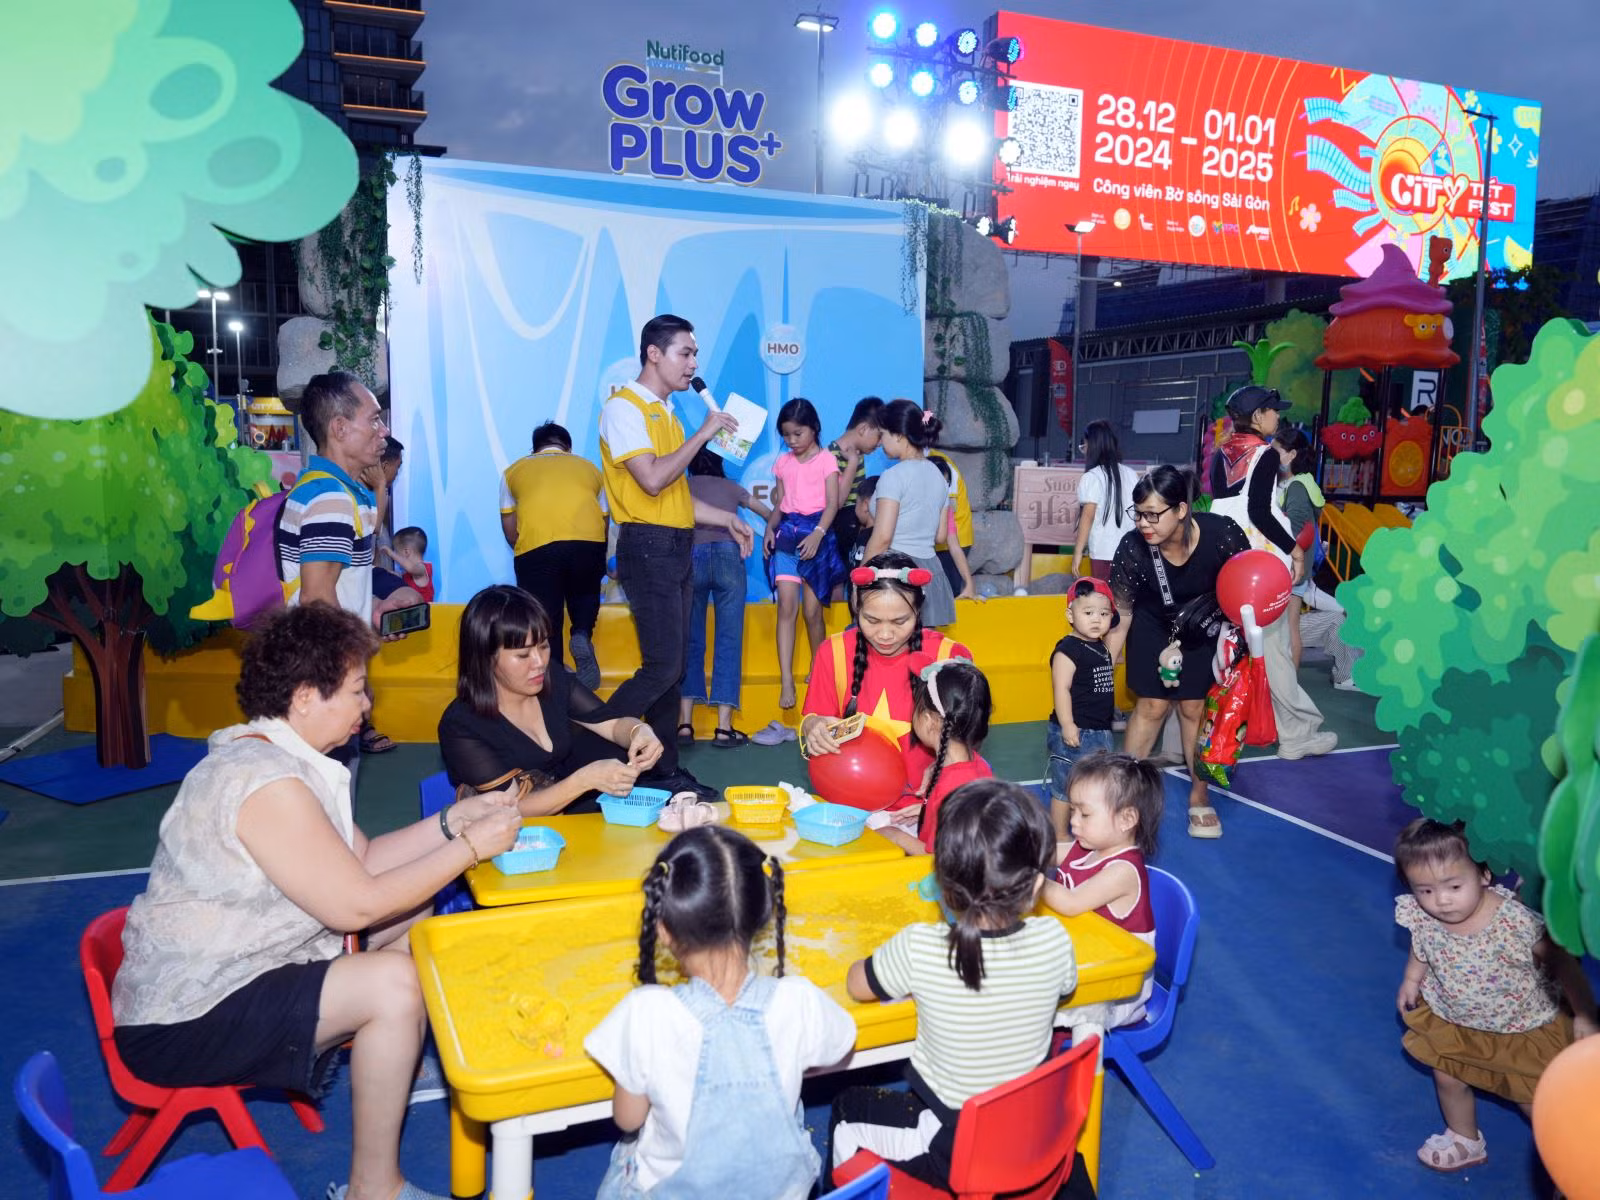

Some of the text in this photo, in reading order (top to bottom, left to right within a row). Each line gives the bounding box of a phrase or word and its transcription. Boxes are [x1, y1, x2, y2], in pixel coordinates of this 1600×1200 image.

[647, 40, 724, 66] Nutifood
[602, 64, 766, 132] Grow
[1097, 94, 1176, 134] 28.12
[1204, 109, 1276, 148] 01.01
[1094, 131, 1173, 171] 2024
[1202, 145, 1274, 182] 2025
[1057, 179, 1080, 192] ngay
[1093, 177, 1271, 211] Công viên Bờ sông Sài Gòn
[767, 343, 799, 355] HMO
